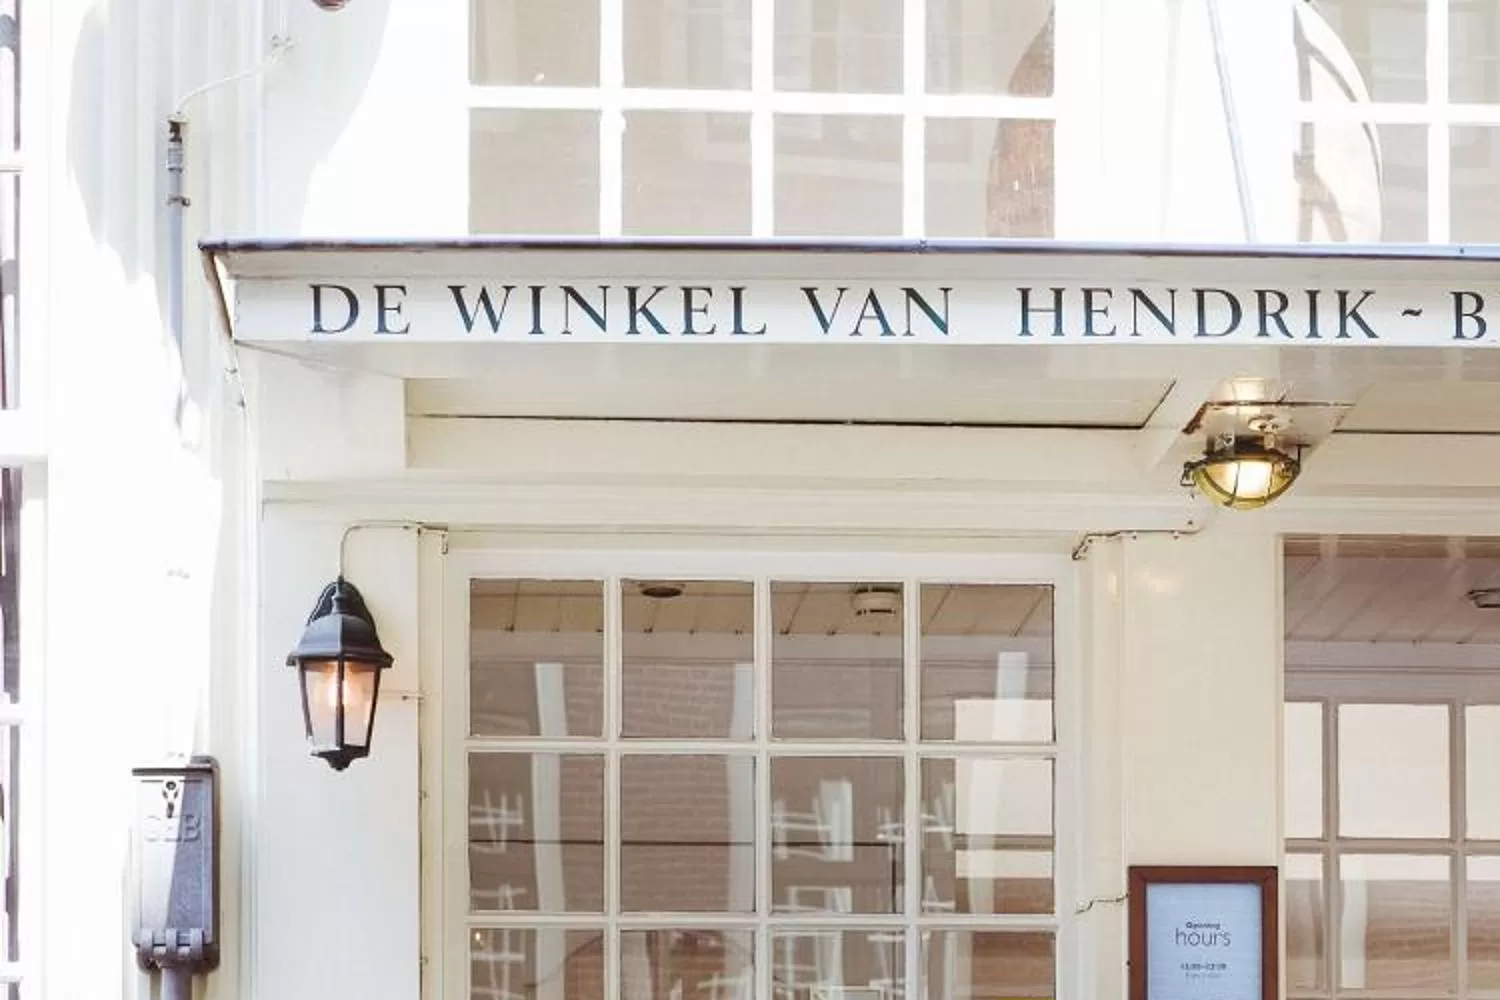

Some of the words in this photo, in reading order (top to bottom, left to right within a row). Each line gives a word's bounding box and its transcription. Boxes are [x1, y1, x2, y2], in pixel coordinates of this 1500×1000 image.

[308, 283, 411, 335] DE
[447, 284, 768, 336] WINKEL
[801, 286, 953, 337] VAN
[1016, 287, 1380, 340] HENDRIK
[1175, 927, 1232, 947] hours
